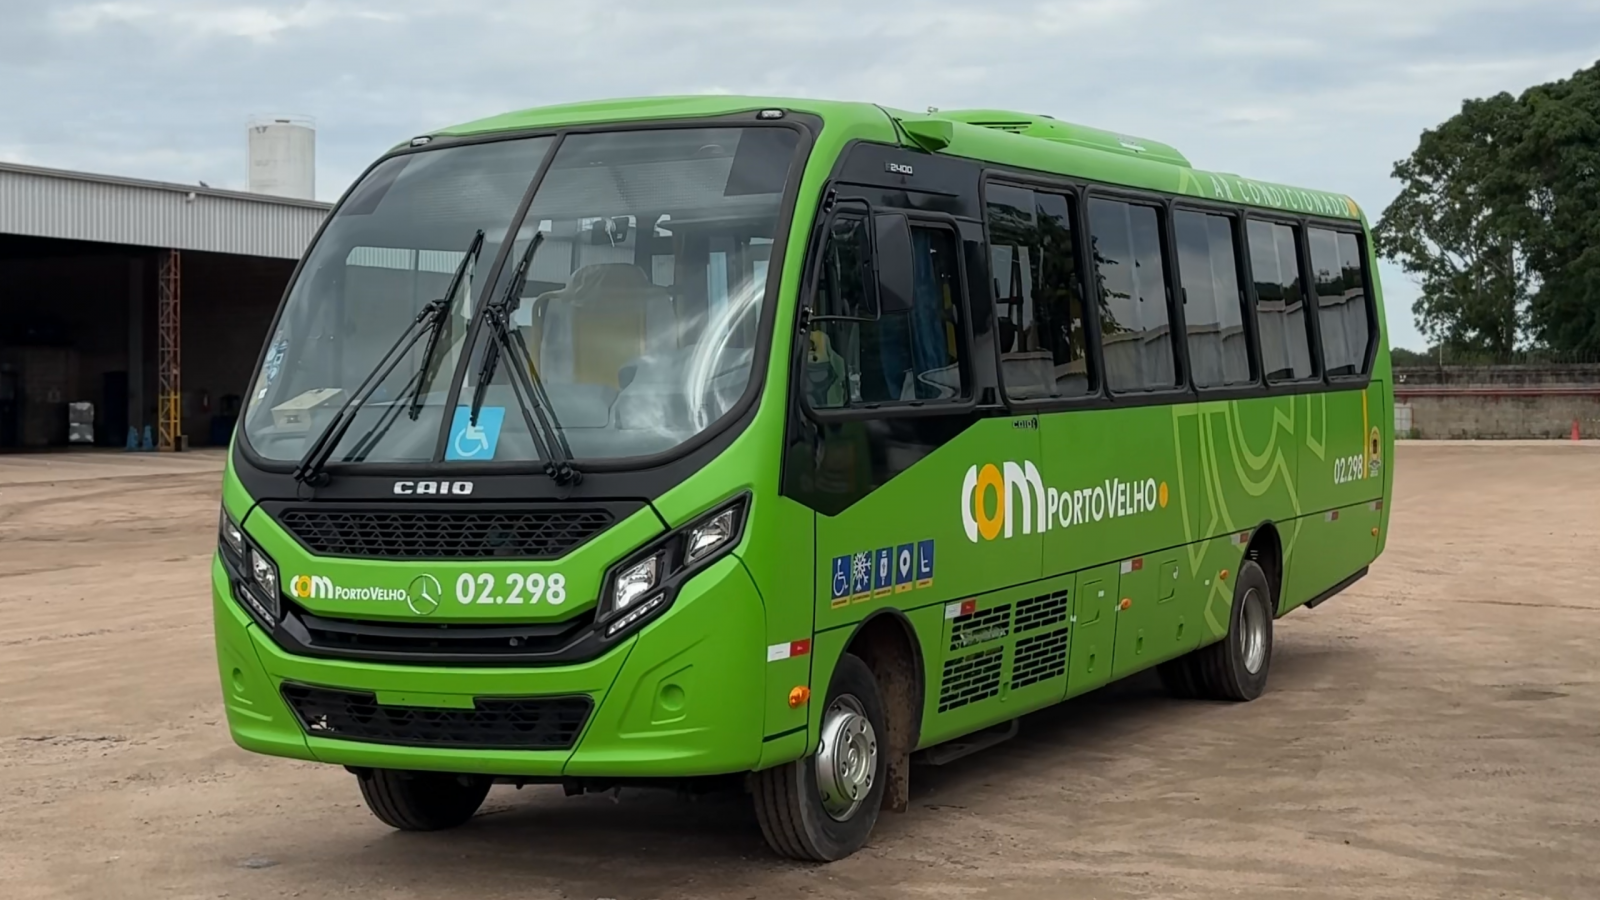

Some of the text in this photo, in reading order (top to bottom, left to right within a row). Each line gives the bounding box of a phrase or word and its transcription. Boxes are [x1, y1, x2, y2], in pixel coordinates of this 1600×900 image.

[1236, 180, 1349, 217] CONDICIONADO
[1333, 453, 1363, 485] 02.298
[393, 481, 474, 495] CAIO
[455, 572, 567, 605] 02.298
